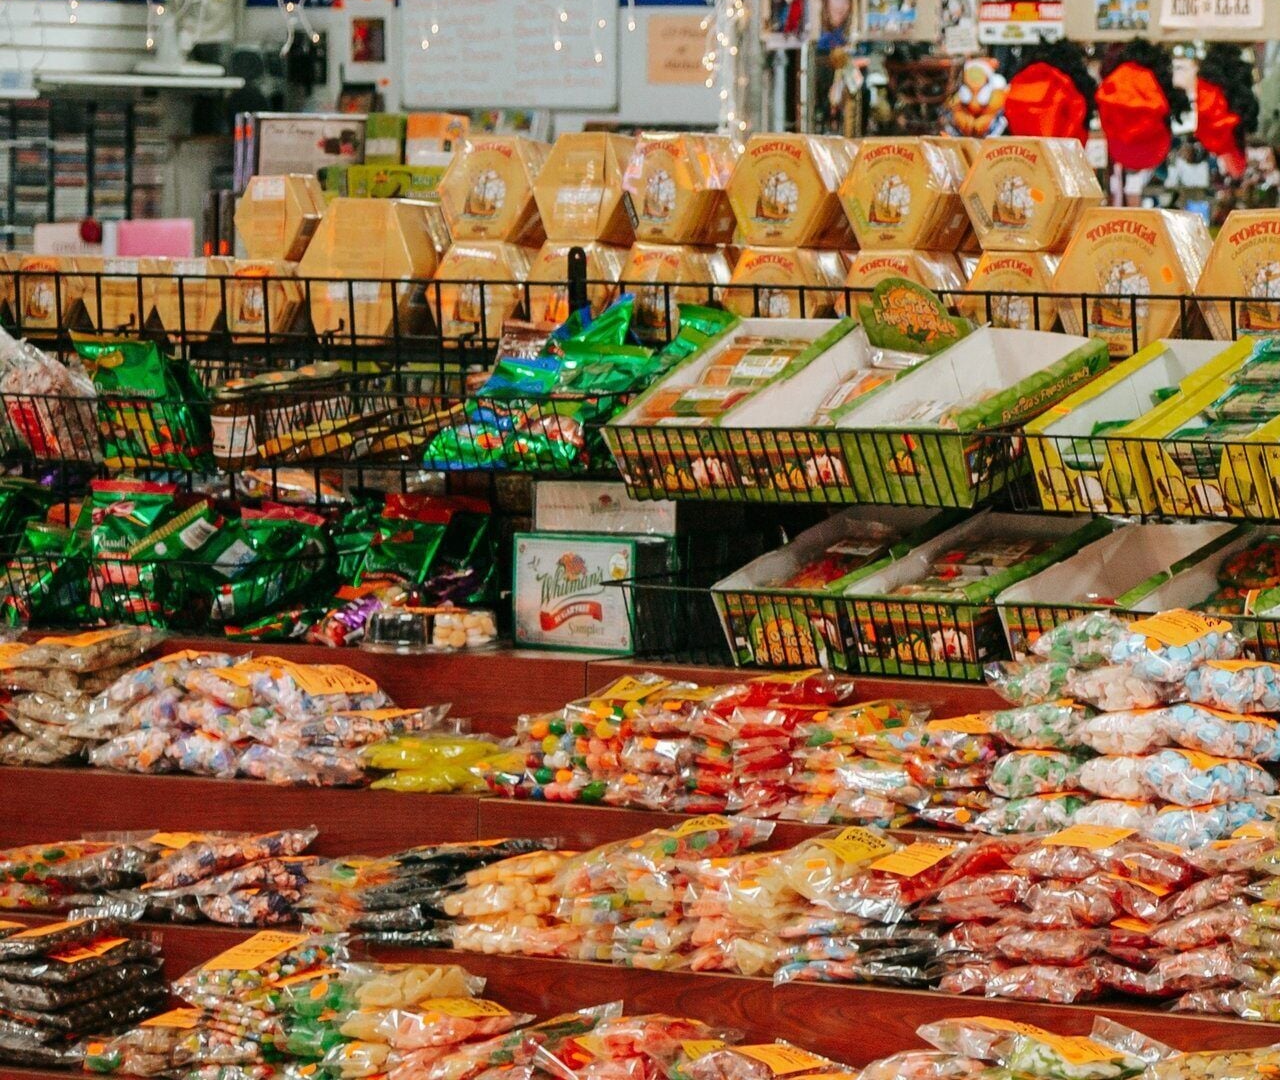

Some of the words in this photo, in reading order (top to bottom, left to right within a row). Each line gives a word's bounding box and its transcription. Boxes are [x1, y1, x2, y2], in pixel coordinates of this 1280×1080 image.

[750, 141, 802, 161] TORTUGA
[863, 143, 915, 162] TORTUGA
[985, 145, 1038, 165] TORTUGA
[1086, 219, 1157, 246] TORTUGA
[744, 254, 795, 273] TORTUGA
[858, 257, 910, 276] TORTUGA
[982, 258, 1035, 278] TORTUGA
[536, 565, 604, 606] Whitman's
[568, 622, 605, 637] Sampler
